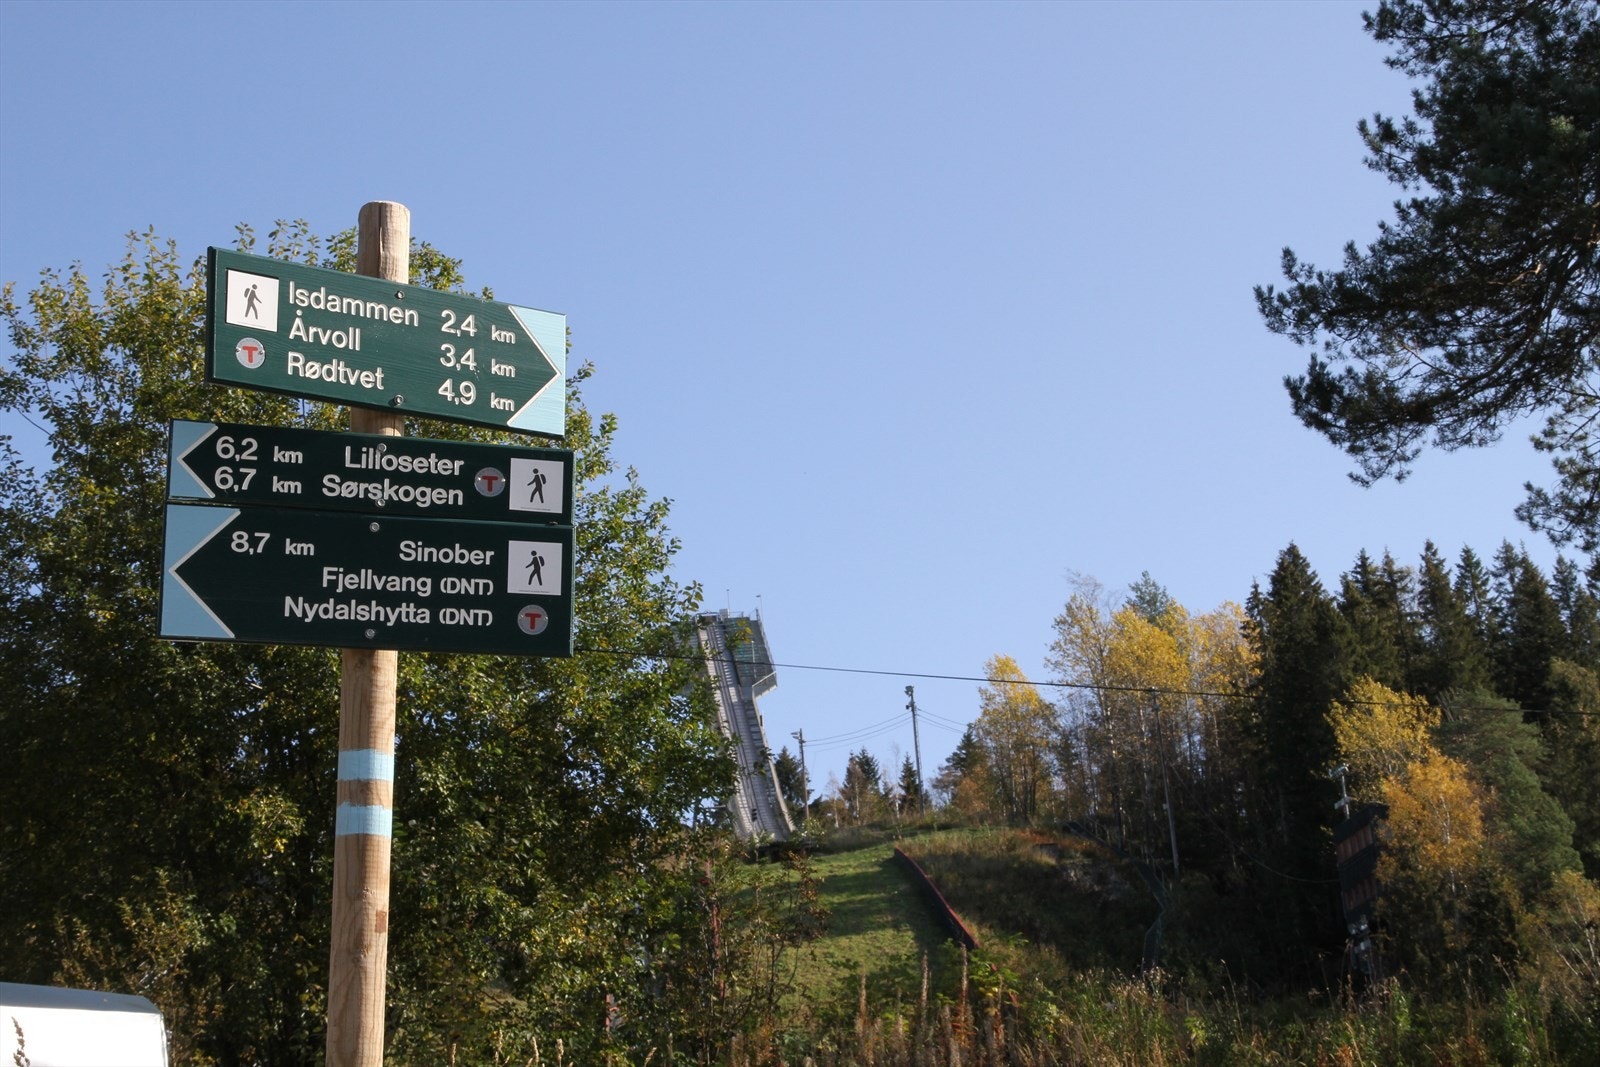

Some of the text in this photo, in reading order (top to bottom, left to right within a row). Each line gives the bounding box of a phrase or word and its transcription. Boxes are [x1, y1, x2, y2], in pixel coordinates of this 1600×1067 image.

[289, 280, 516, 344] Isdammen 2,4 km
[242, 345, 258, 364] T
[288, 309, 516, 378] Årvoll 3,4 km
[287, 351, 515, 412] Rødtvet 4,9 km
[216, 435, 465, 476] 6,2 km Lilloseter
[214, 466, 464, 508] 6,7 km Sørskogen
[481, 475, 499, 493] T
[230, 531, 495, 565] 8,7 km Sinober
[322, 566, 494, 597] Fjellvang (DNT)
[284, 595, 493, 627] Nydalshytta (DNT)
[525, 612, 542, 630] T
